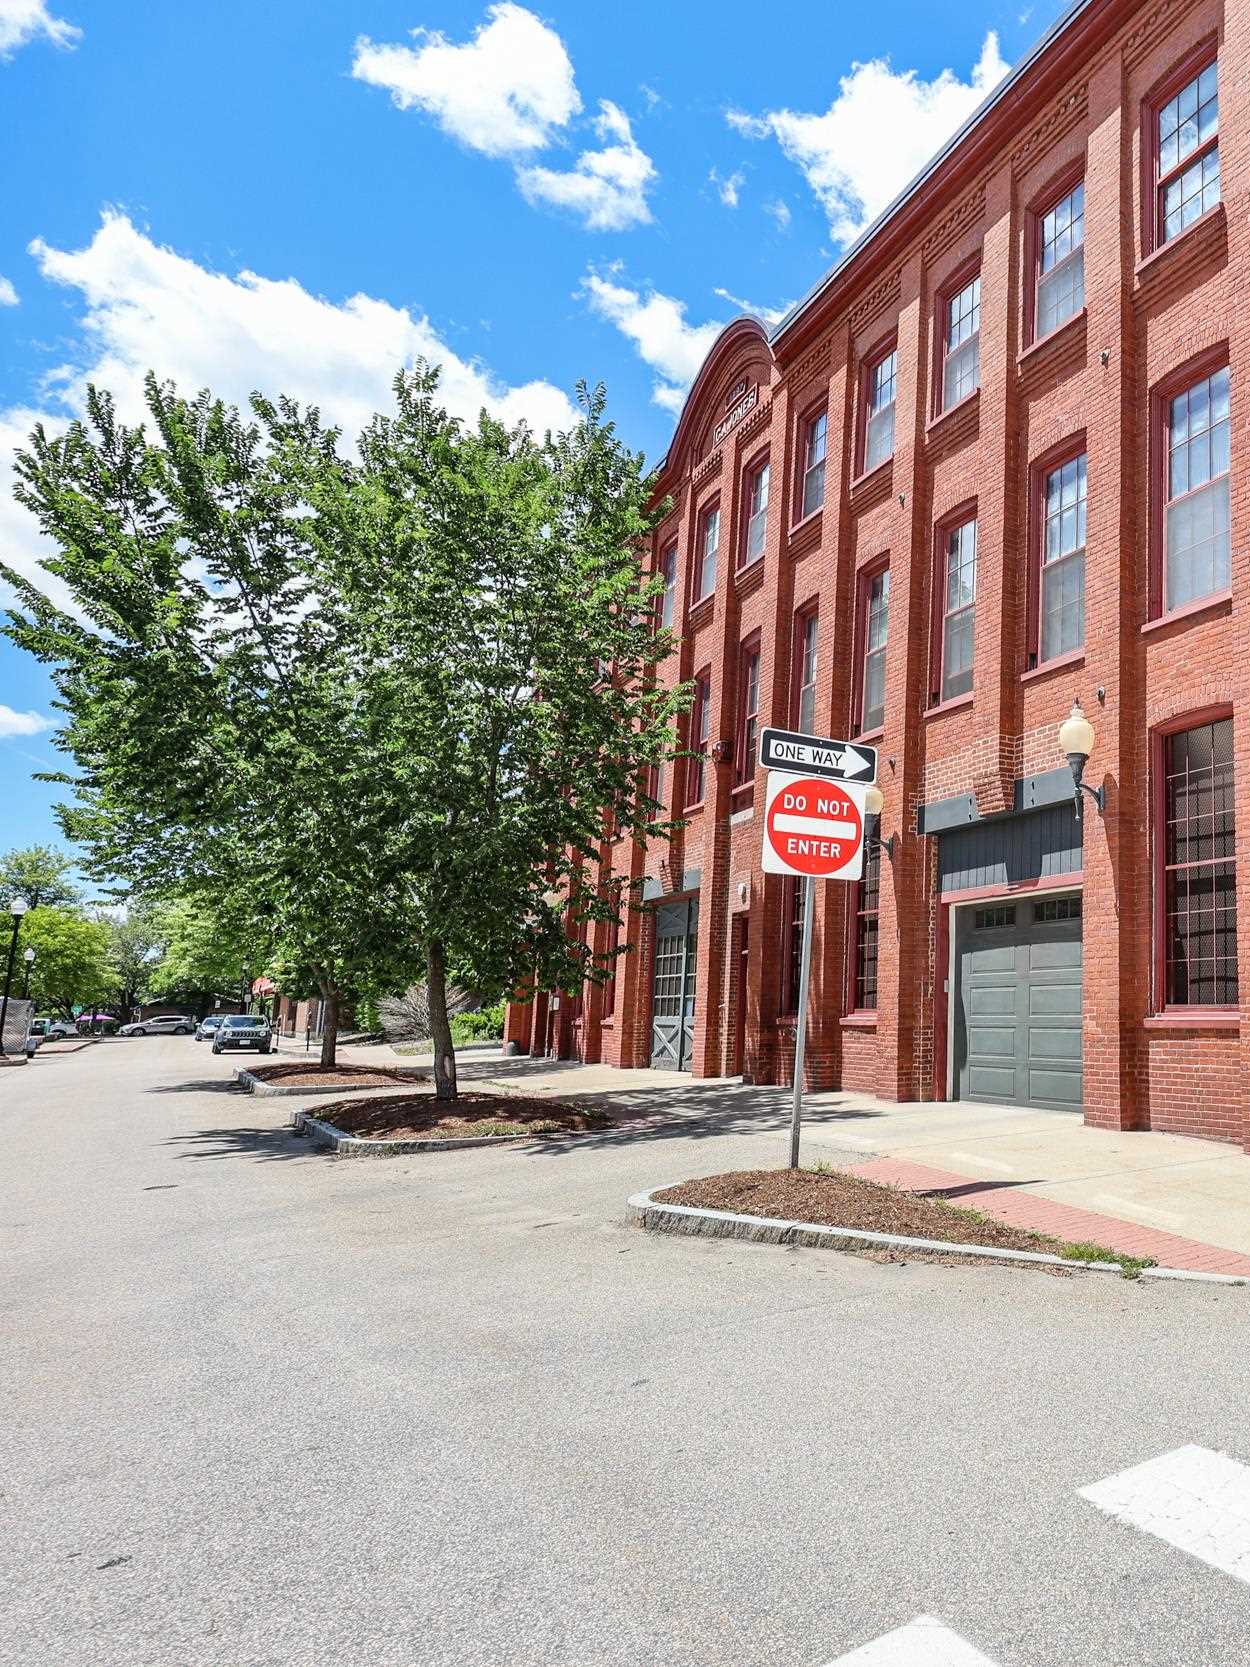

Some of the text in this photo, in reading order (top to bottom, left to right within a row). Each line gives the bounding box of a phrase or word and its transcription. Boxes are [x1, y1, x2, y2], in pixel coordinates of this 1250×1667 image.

[774, 743, 843, 767] ONE WAY
[783, 794, 850, 816] DO NOT
[787, 838, 841, 858] ENTER
